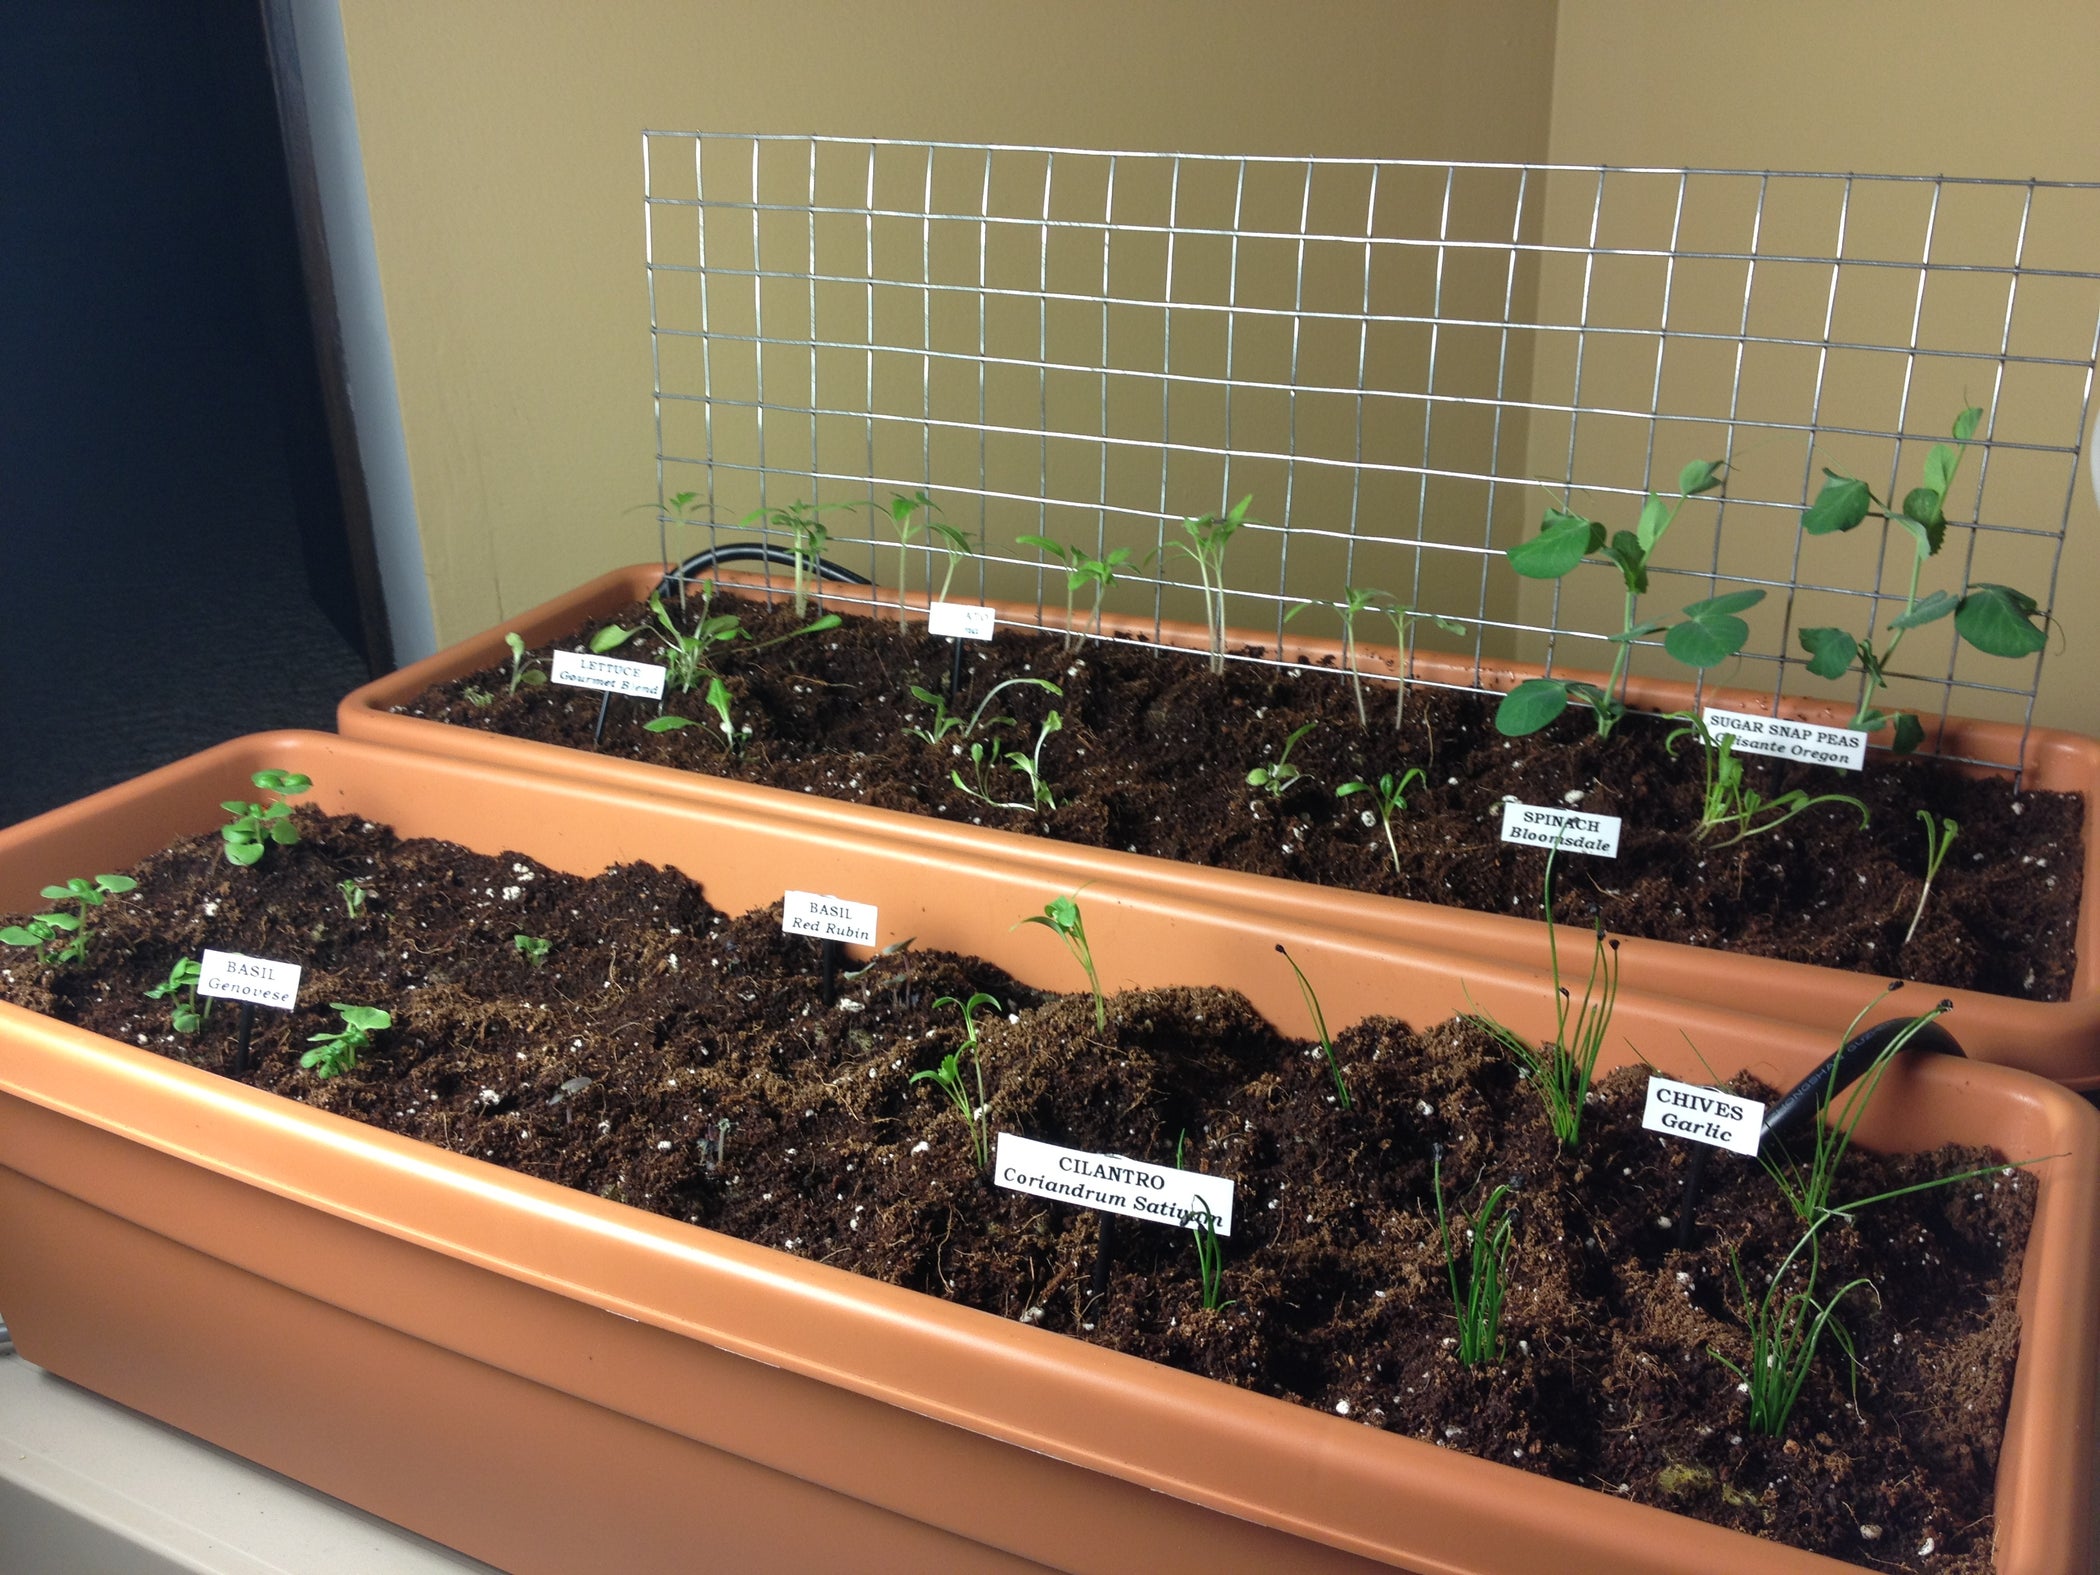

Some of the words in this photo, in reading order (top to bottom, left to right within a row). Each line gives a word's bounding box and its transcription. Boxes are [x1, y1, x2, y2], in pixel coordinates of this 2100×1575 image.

[559, 670, 616, 688] Gourmet
[580, 659, 641, 677] LETTUCE
[1710, 715, 1764, 733] SUGAR
[1768, 724, 1812, 741] SNAP
[1817, 732, 1860, 748] PEAS
[1715, 732, 1786, 754] isante
[1791, 745, 1849, 763] Oregon
[1523, 811, 1600, 832] SPINACH
[1510, 826, 1611, 852] Bloomsdale
[810, 902, 852, 920] BASIL
[792, 917, 820, 932] Red
[826, 923, 869, 940] Rubin
[227, 961, 276, 980] BASIL
[208, 977, 289, 1001] Genovese
[1656, 1088, 1744, 1121] CHIVES
[1661, 1113, 1732, 1142] Garlic
[1059, 1156, 1165, 1190] CILANTRO
[1003, 1167, 1126, 1208] Coriandrum
